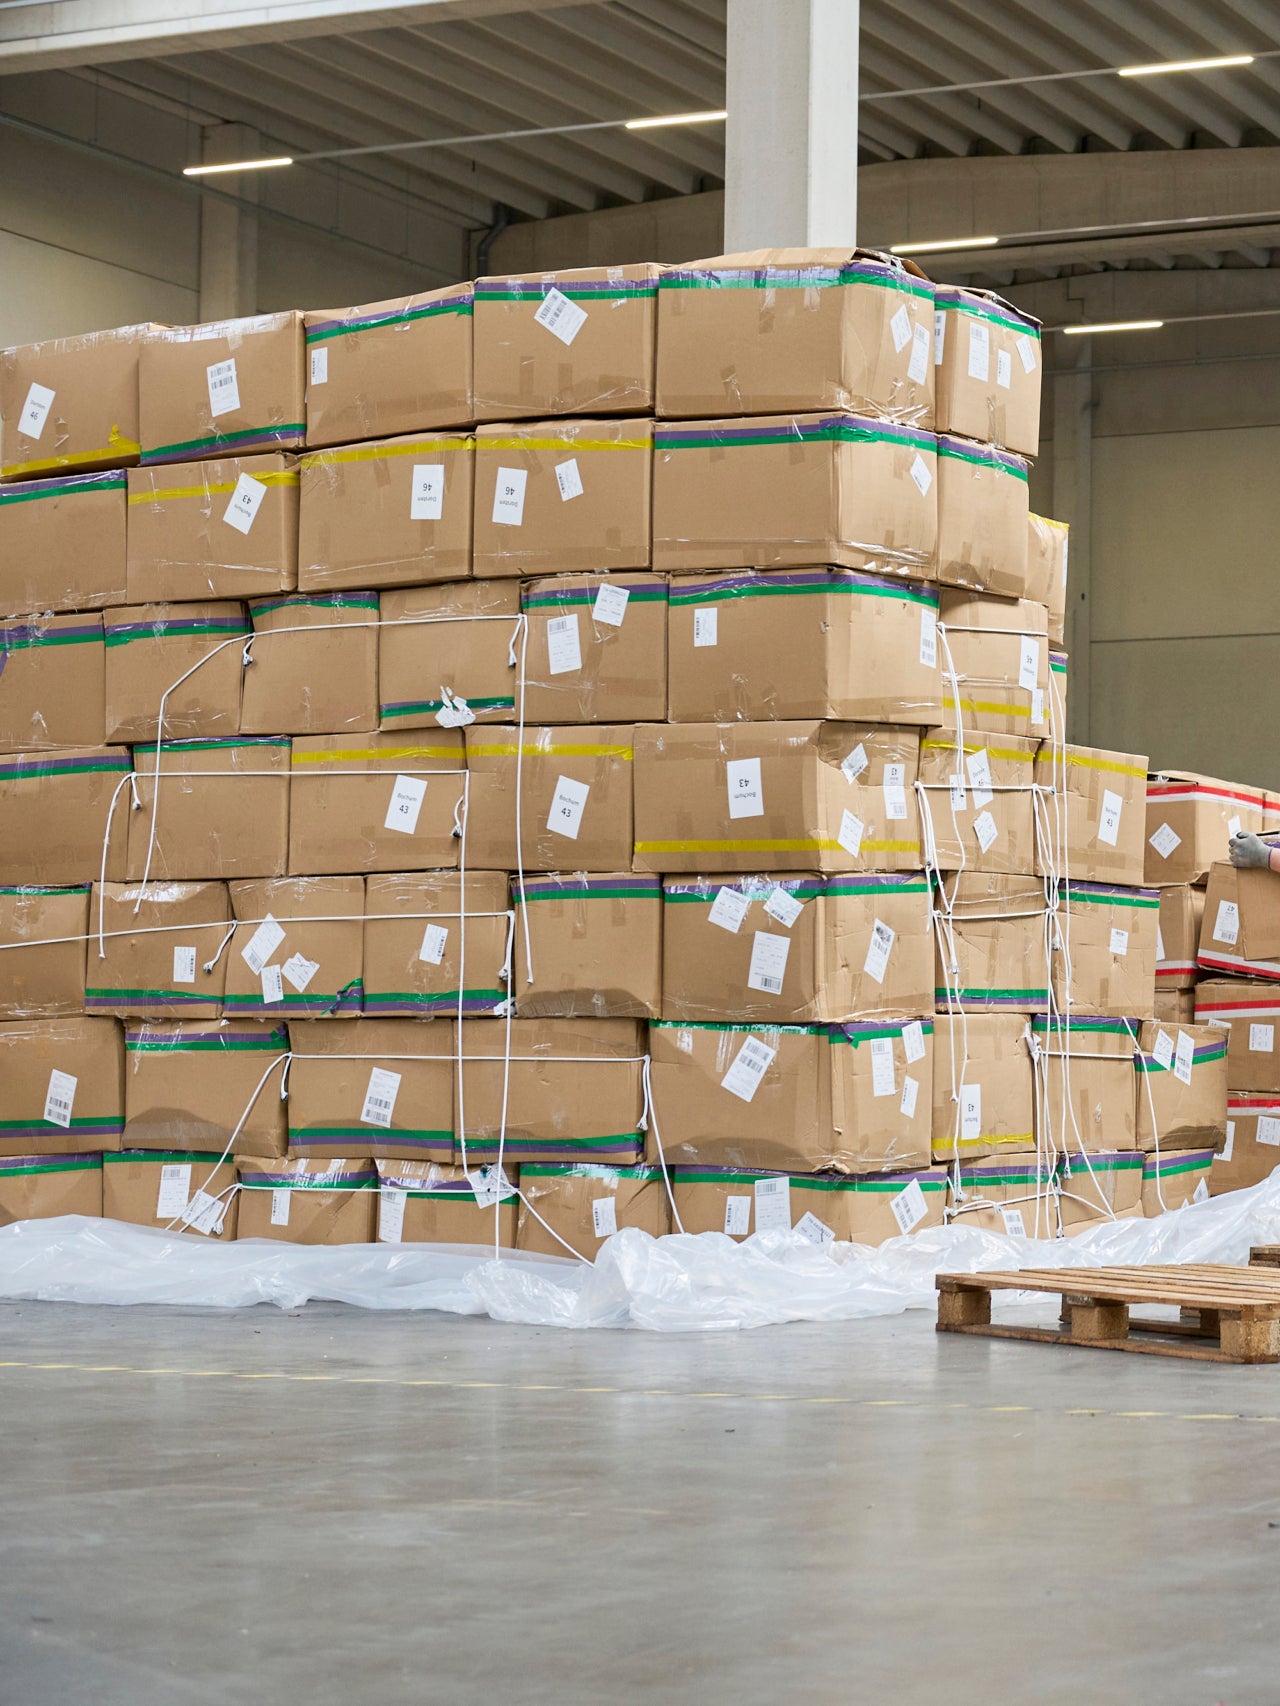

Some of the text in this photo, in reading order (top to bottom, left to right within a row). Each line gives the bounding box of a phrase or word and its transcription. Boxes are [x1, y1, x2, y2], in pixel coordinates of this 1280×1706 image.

[30, 411, 39, 421] 46
[422, 482, 432, 492] 46
[505, 486, 515, 497] 46
[242, 494, 252, 506] 43
[739, 778, 751, 788] 43
[558, 794, 580, 806] Bochum
[733, 791, 757, 800] Bochum
[399, 804, 410, 815] 43
[561, 806, 572, 818] 43
[967, 1103, 976, 1113] 43
